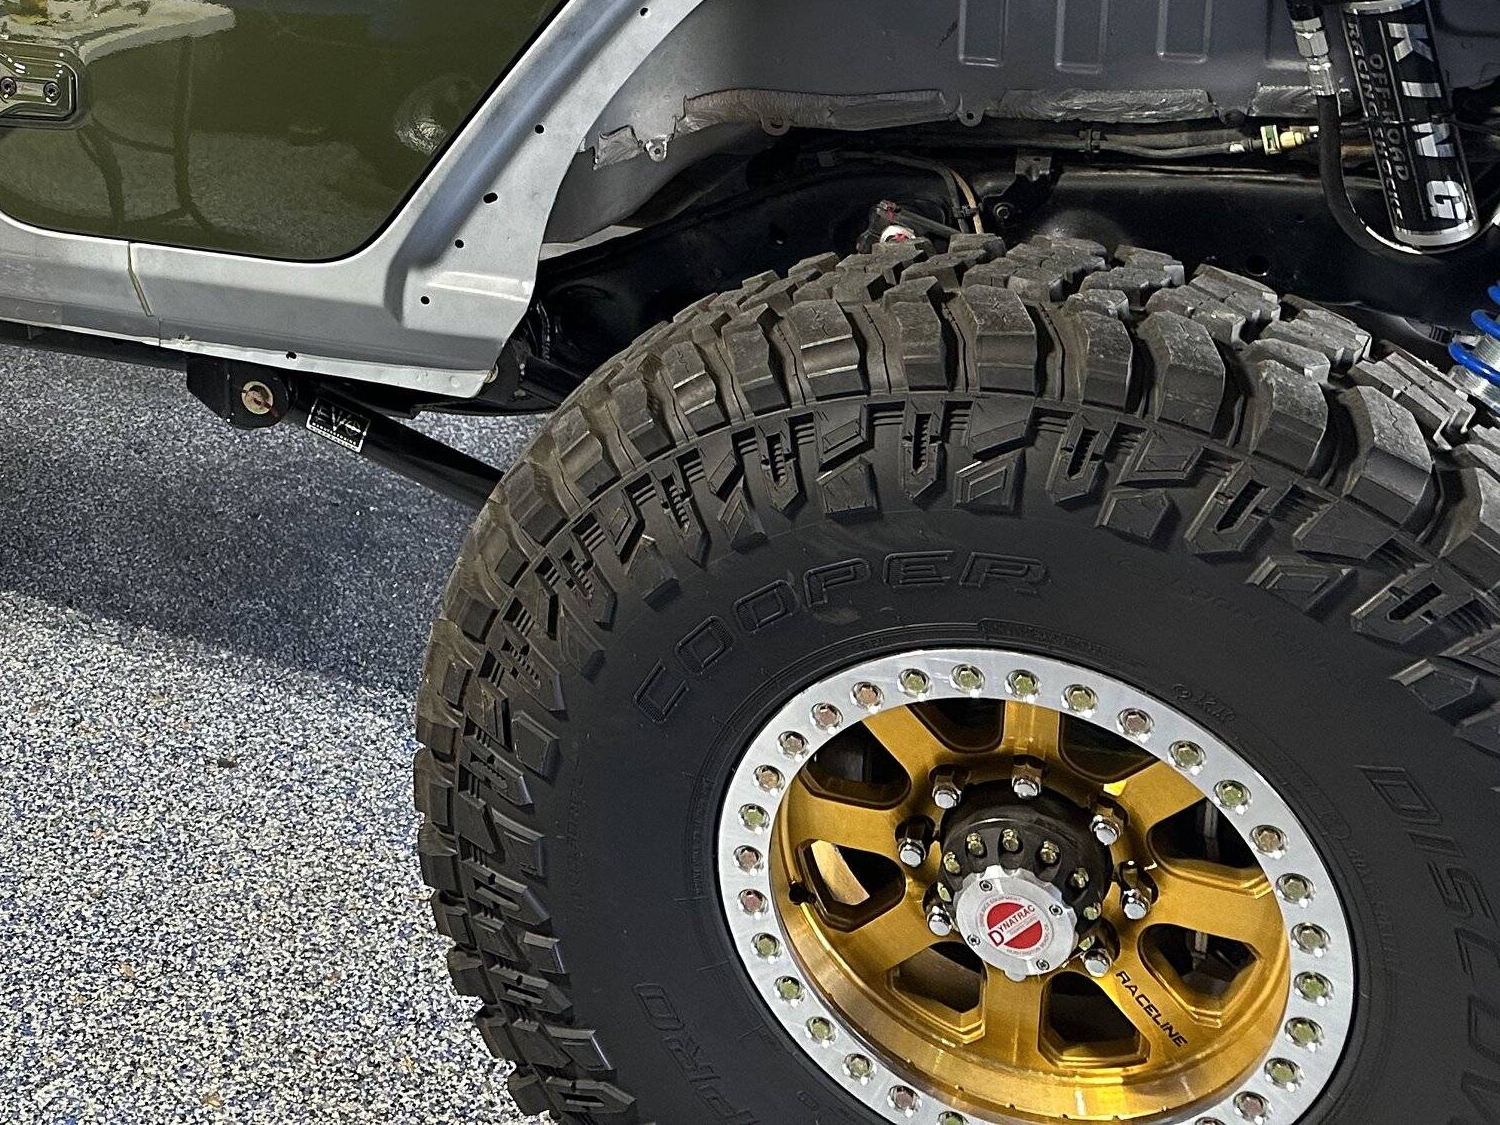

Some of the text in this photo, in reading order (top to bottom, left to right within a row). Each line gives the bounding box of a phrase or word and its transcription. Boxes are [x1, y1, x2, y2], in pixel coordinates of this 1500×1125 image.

[1348, 22, 1379, 118] RACING
[1387, 22, 1469, 221] KING
[631, 548, 1054, 725] COOPER
[987, 904, 1037, 948] DYNATRAC
[1115, 970, 1188, 1048] RACELINE
